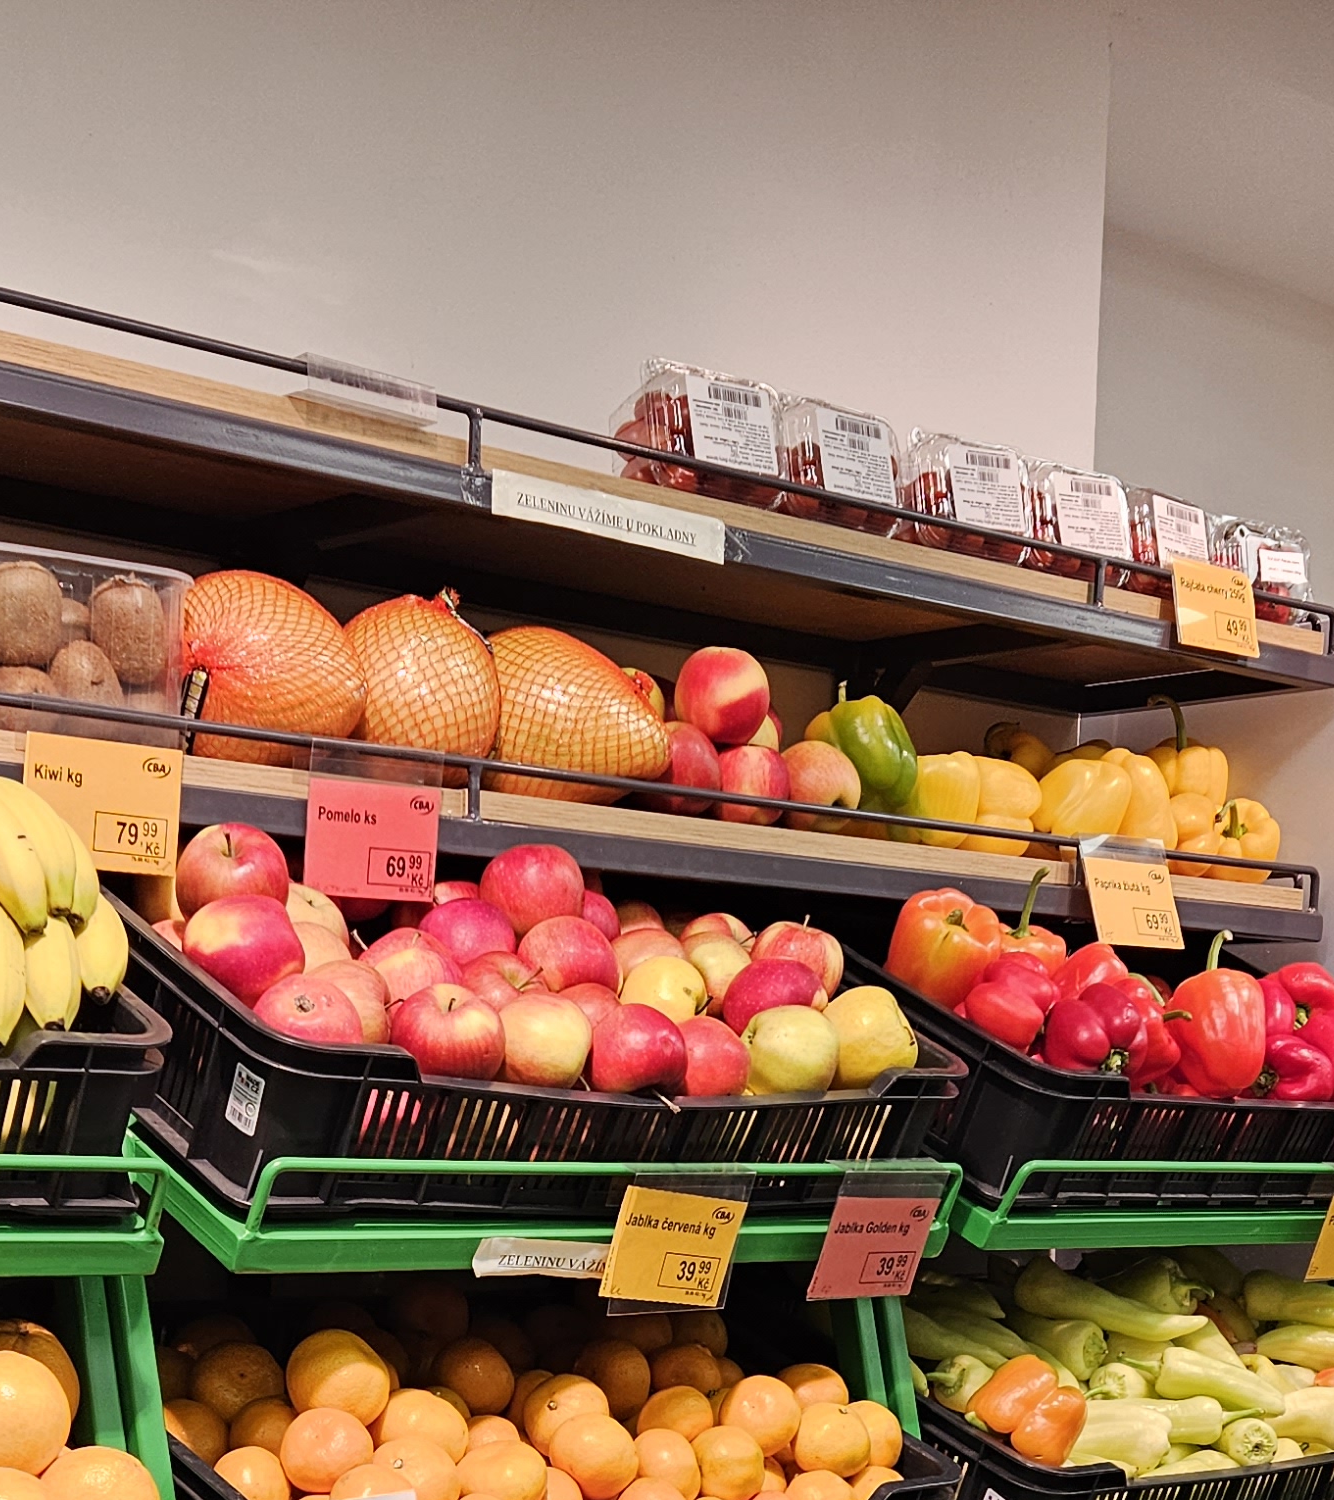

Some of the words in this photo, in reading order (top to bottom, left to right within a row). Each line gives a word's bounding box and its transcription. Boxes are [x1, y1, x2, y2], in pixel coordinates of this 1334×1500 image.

[517, 492, 576, 516] ZELENINU
[578, 506, 623, 528] VÁŽÍME
[626, 519, 633, 530] U
[637, 522, 697, 545] POKLADNY
[34, 763, 62, 781] Kiwi
[67, 768, 83, 787] kg
[147, 763, 166, 773] CBA
[318, 806, 360, 823] Pomelo
[364, 810, 377, 825] ks
[142, 821, 158, 837] 99
[145, 842, 160, 856] Kč
[409, 855, 422, 869] 99
[411, 874, 424, 887] Kč
[625, 1212, 658, 1230] Jablka
[661, 1217, 701, 1236] červená
[703, 1224, 716, 1239] kg
[834, 1222, 864, 1234] Jablka
[866, 1221, 896, 1234] Golden
[898, 1222, 910, 1236] kg
[498, 1254, 566, 1269] ZELENINU
[699, 1261, 712, 1275] 99
[896, 1255, 908, 1267] 99
[697, 1278, 710, 1290] Kč
